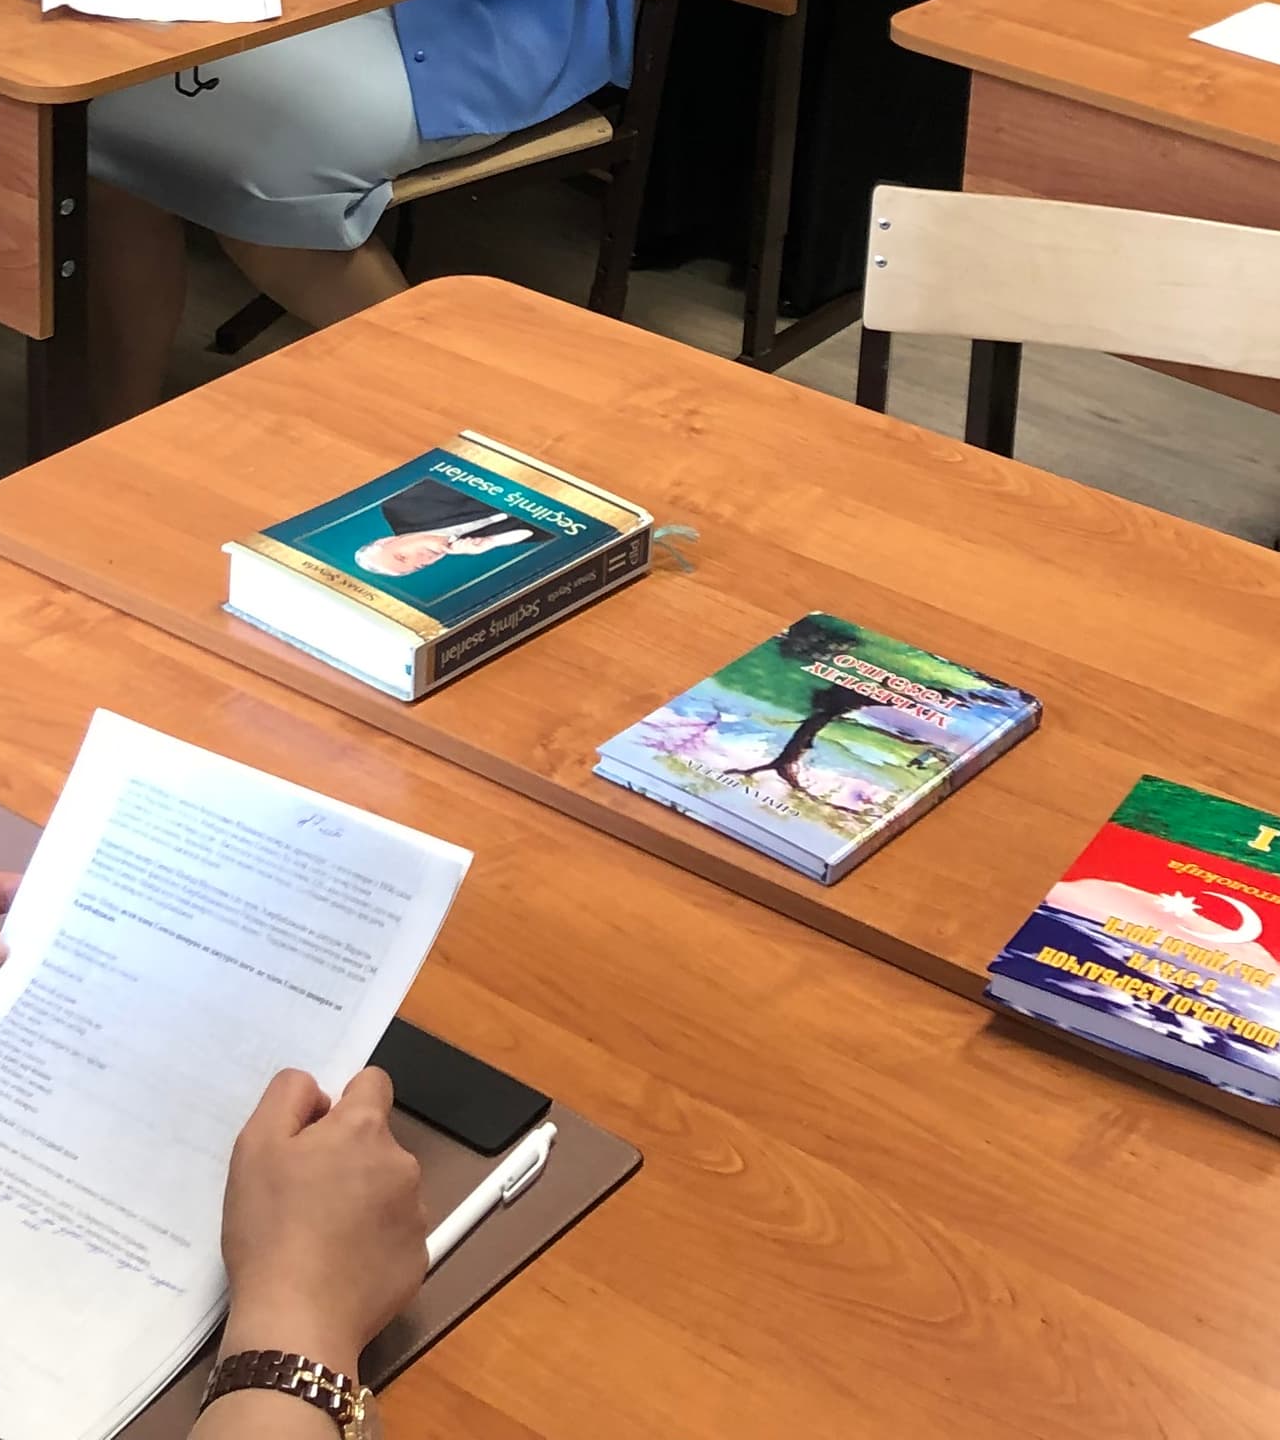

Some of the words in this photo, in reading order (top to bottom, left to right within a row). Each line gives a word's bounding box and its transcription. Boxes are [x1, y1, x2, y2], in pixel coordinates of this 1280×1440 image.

[426, 461, 506, 496] əsərləri
[497, 492, 589, 535] Seçilmiş
[489, 594, 540, 641] Seçilmiş
[440, 628, 486, 668] əsərləri
